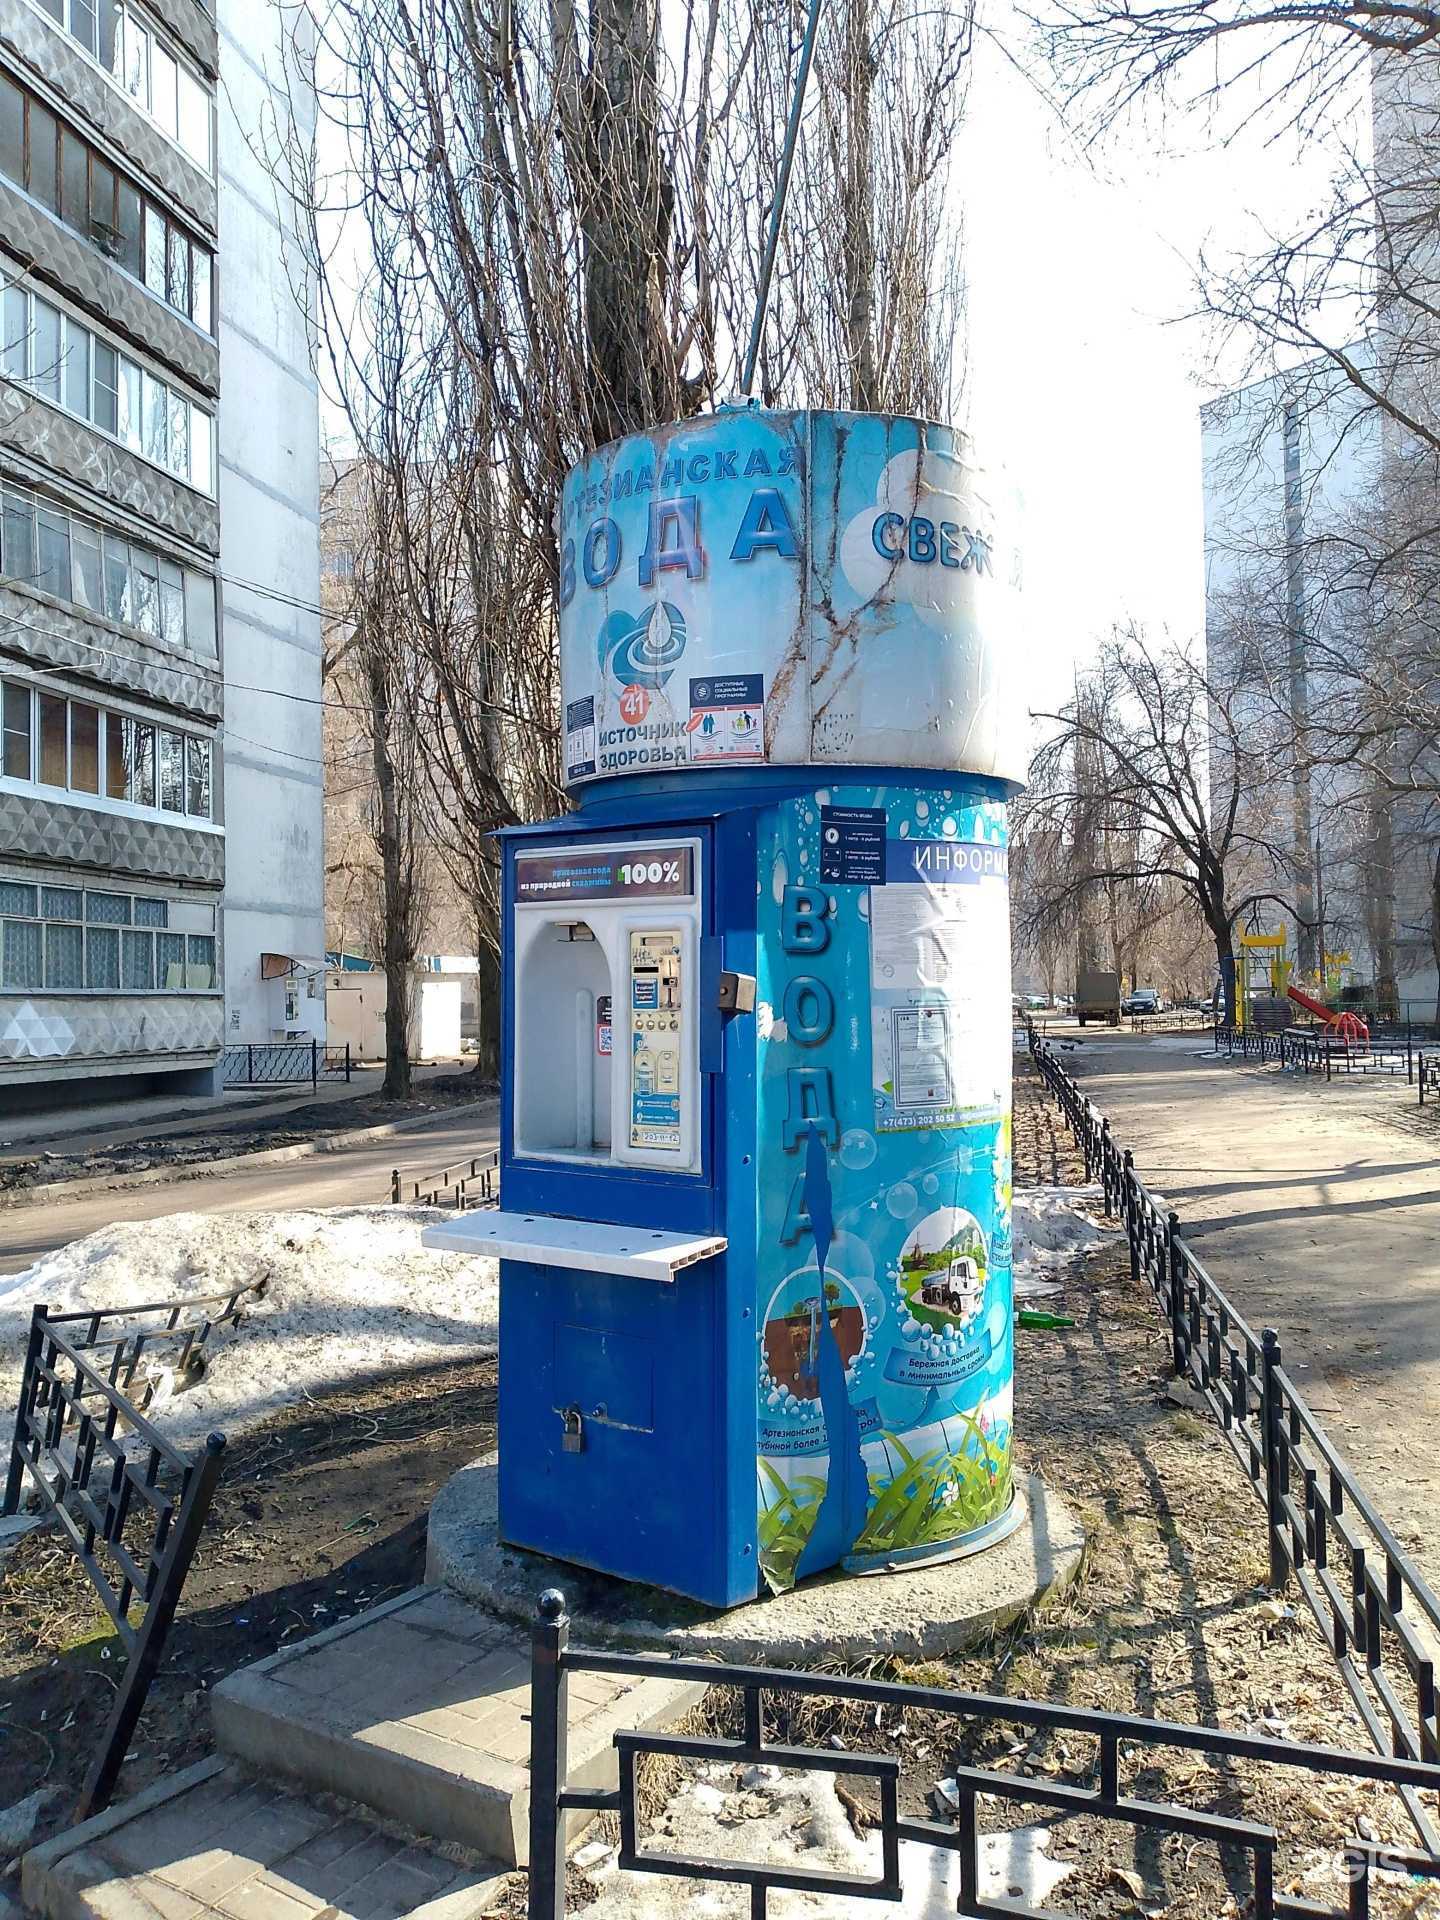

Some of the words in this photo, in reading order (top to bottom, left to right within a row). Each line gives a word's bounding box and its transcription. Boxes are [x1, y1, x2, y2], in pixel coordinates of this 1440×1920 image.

[560, 487, 803, 609] ВОДА
[624, 692, 644, 716] 41
[599, 721, 687, 747] ИСТОЧНИК
[600, 745, 686, 770] ЗДОРОВЬЯ
[530, 878, 571, 892] природной
[622, 861, 680, 886] 100%
[918, 1115, 934, 1125] 202
[907, 1366, 966, 1381] минимальные
[967, 1353, 985, 1371] сроки
[909, 1358, 950, 1370] Бережная
[950, 1346, 980, 1367] доставка
[762, 1426, 820, 1438] Артезианская
[757, 1441, 791, 1451] лубиной
[793, 1438, 820, 1449] более
